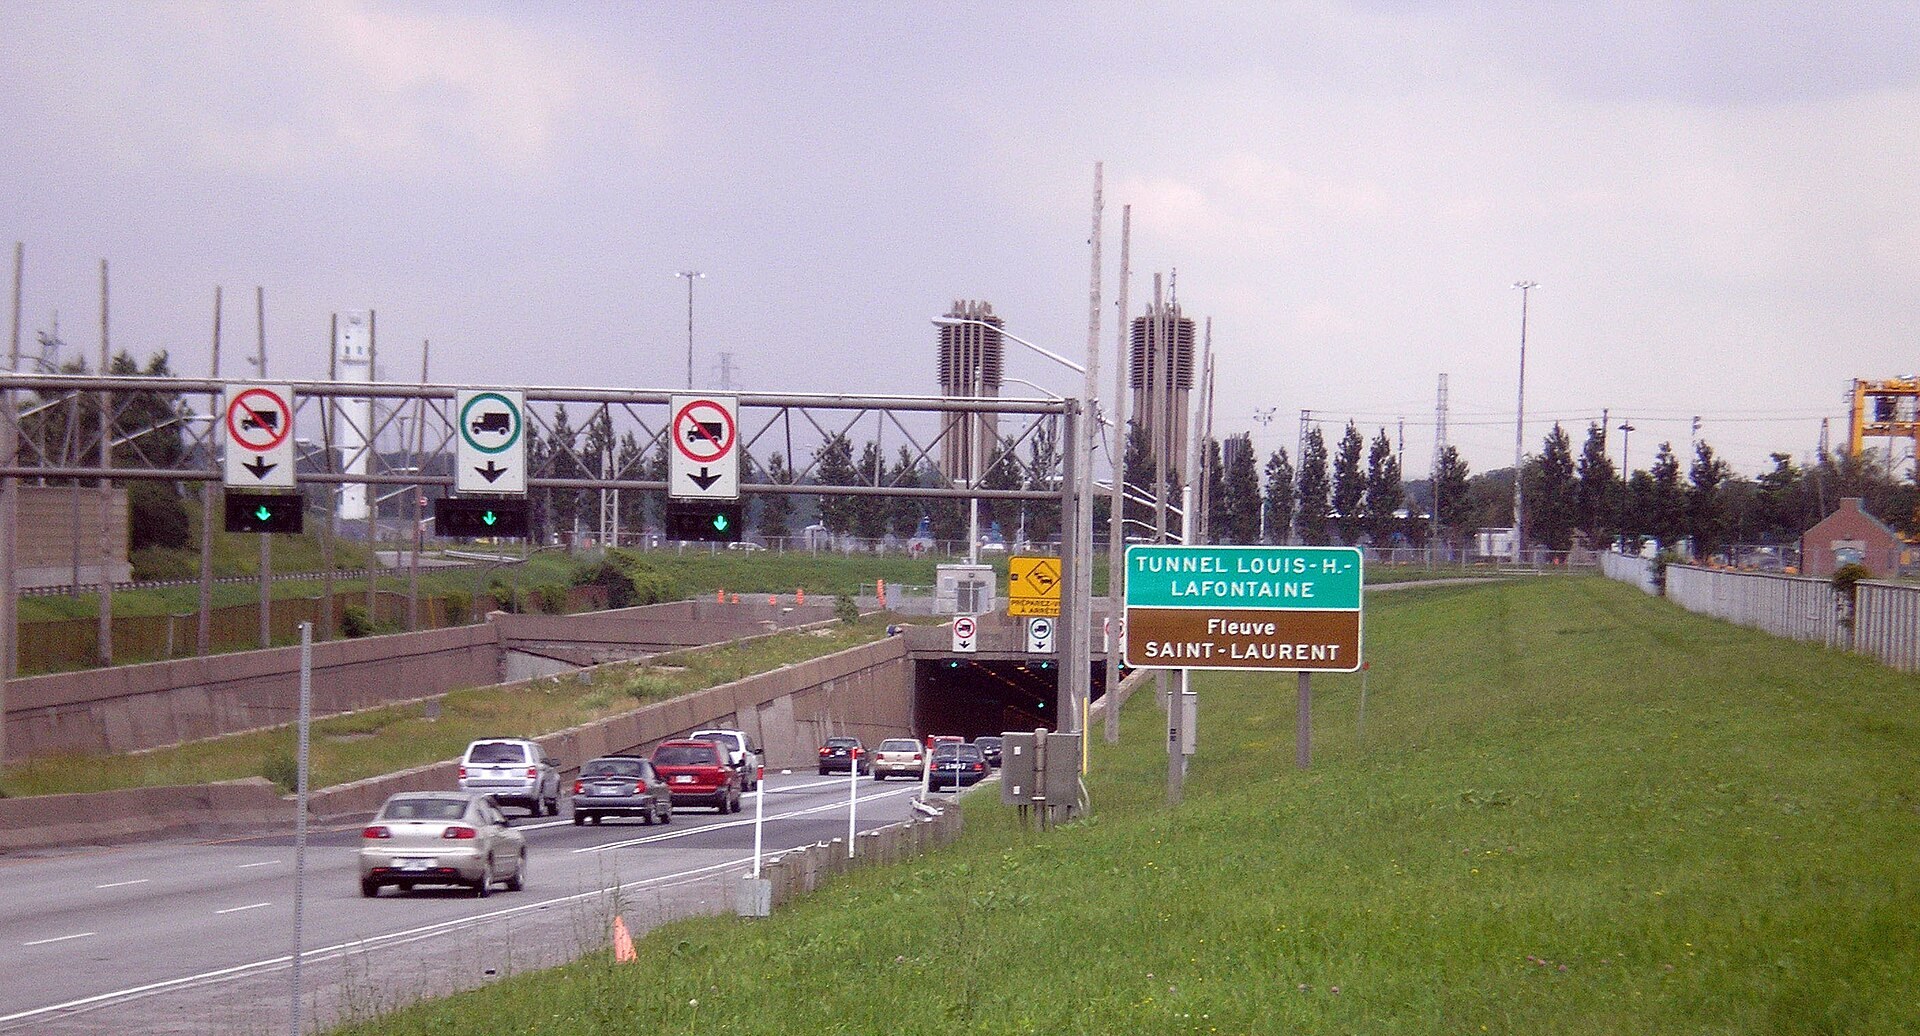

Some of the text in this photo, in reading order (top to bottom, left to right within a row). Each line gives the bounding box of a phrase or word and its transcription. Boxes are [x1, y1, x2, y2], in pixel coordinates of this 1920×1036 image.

[1135, 557, 1228, 574] TUNNEL
[1171, 581, 1315, 598] LAFONTAINE
[1207, 619, 1276, 636] Fleuve
[1145, 642, 1340, 661] SAINT-LAURENT
